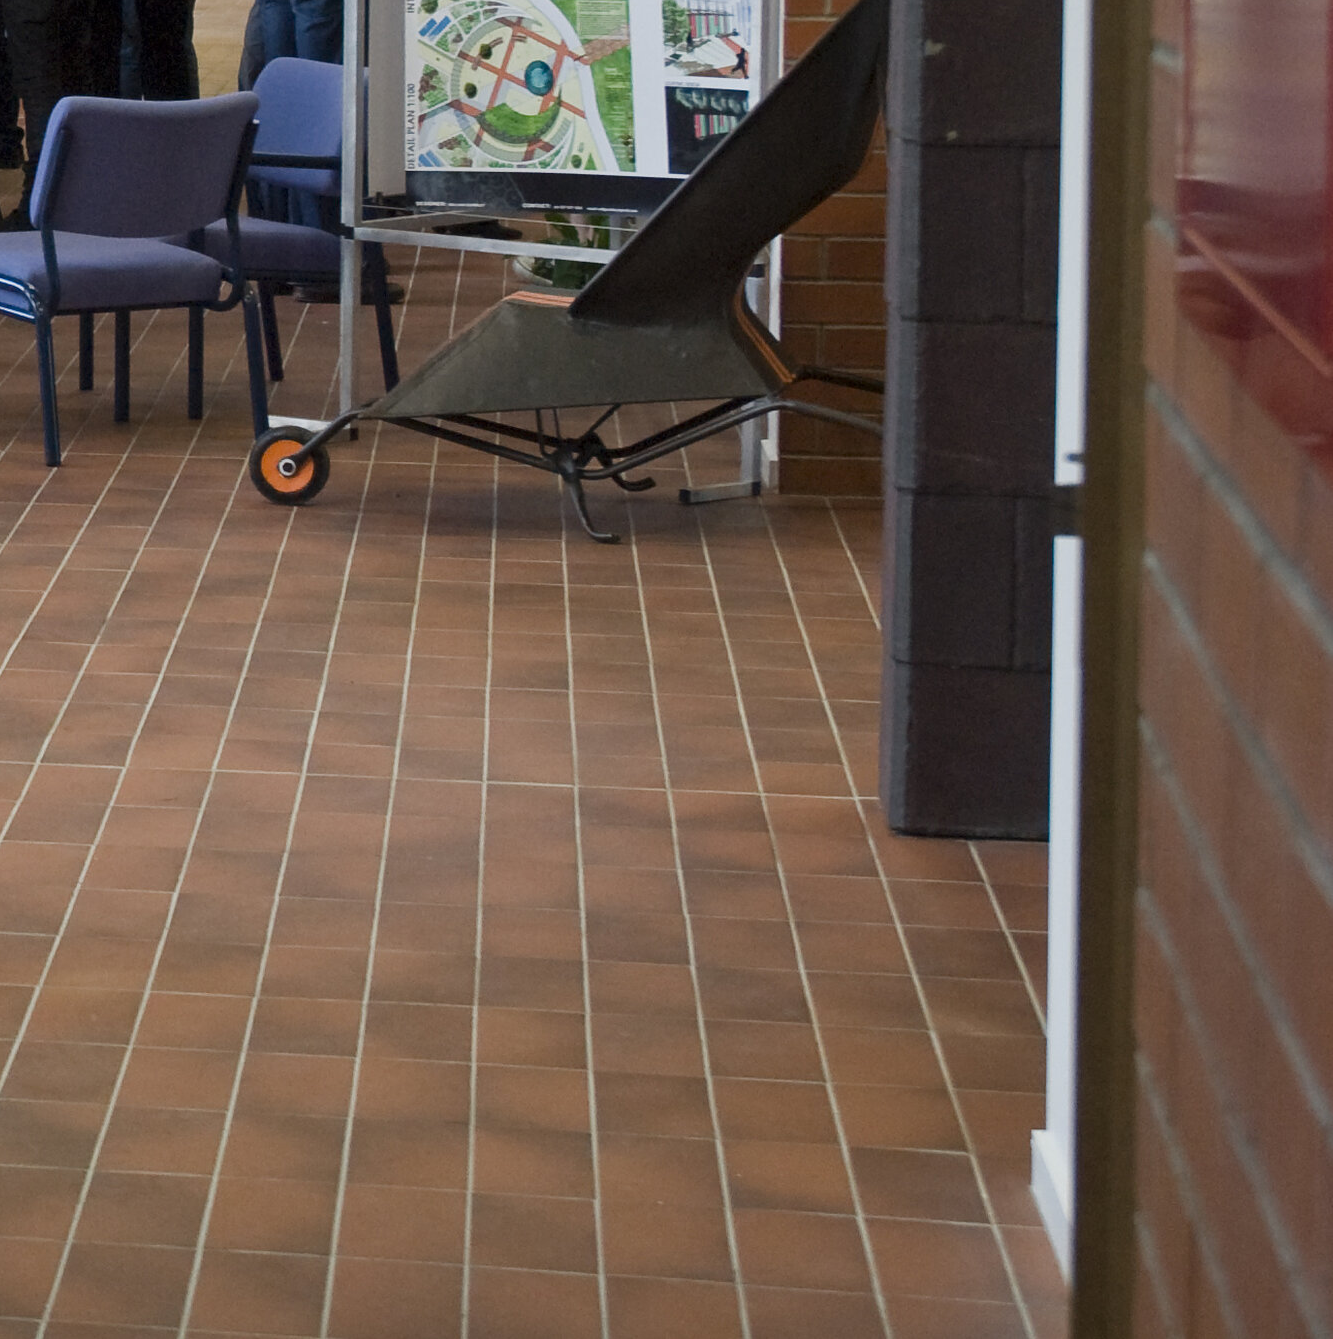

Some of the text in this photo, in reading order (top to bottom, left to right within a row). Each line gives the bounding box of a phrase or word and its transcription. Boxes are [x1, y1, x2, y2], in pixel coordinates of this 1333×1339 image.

[407, 83, 416, 170] DETAIL PLAN 1:100
